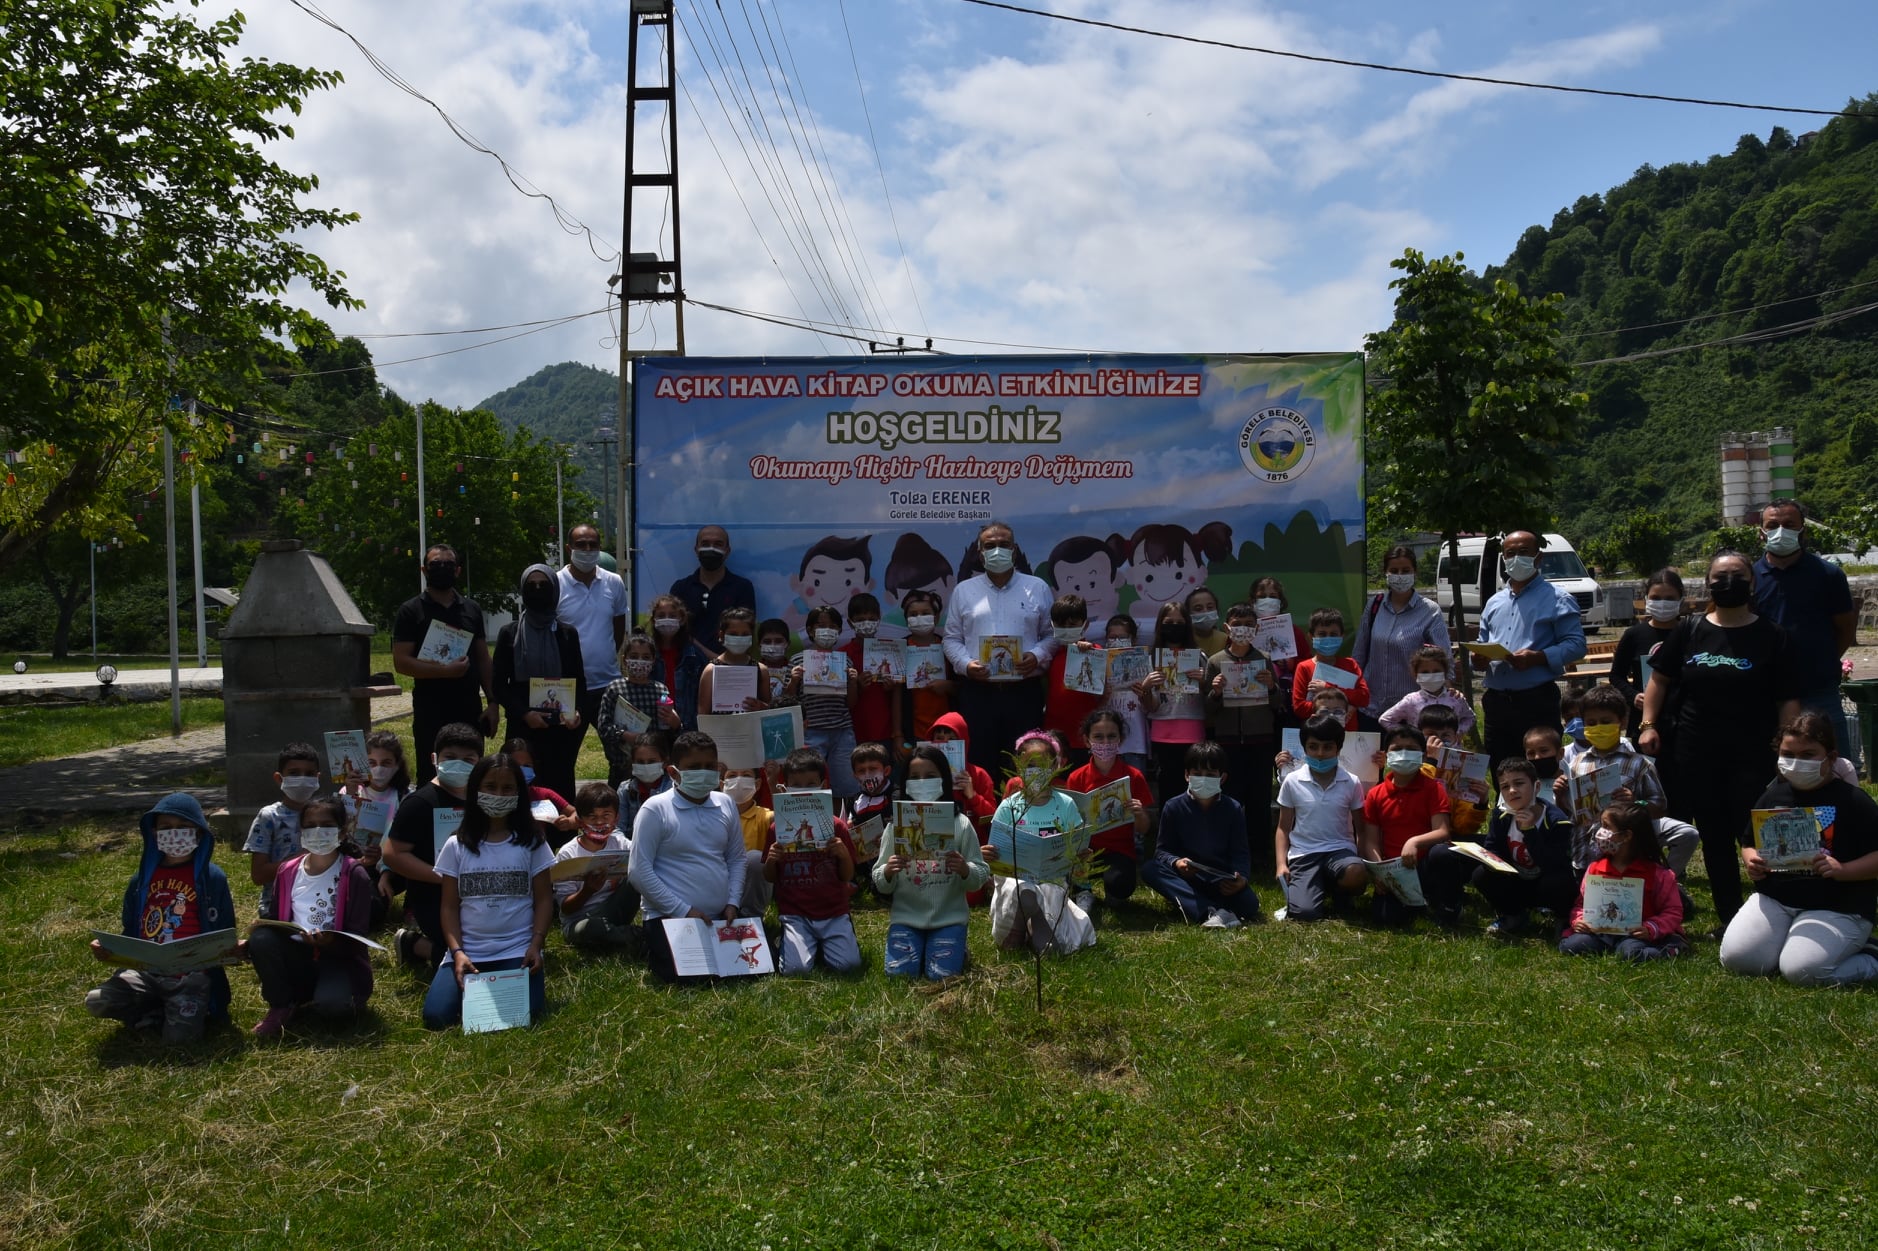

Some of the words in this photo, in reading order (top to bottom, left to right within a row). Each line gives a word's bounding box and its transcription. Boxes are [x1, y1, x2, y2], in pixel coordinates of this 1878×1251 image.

[656, 375, 724, 403] AÇIK
[728, 374, 802, 398] HAVA
[806, 370, 888, 397] KİTAP
[892, 373, 995, 397] OKUMA
[1000, 369, 1201, 397] ETKİNLİĞİMİZE
[827, 405, 1061, 450] HOŞGELDİNİZ
[1268, 409, 1315, 447] BELEDİYESİ
[750, 455, 852, 485] Okumayı
[854, 454, 921, 484] Hiçbir
[924, 455, 1022, 485] Hazineye
[1024, 455, 1134, 485] Değişmem
[1267, 473, 1289, 481] 1876
[890, 491, 927, 505] Tolga
[932, 491, 991, 505] ERENER
[920, 510, 956, 519] Belediye
[958, 510, 991, 520] Başkanı
